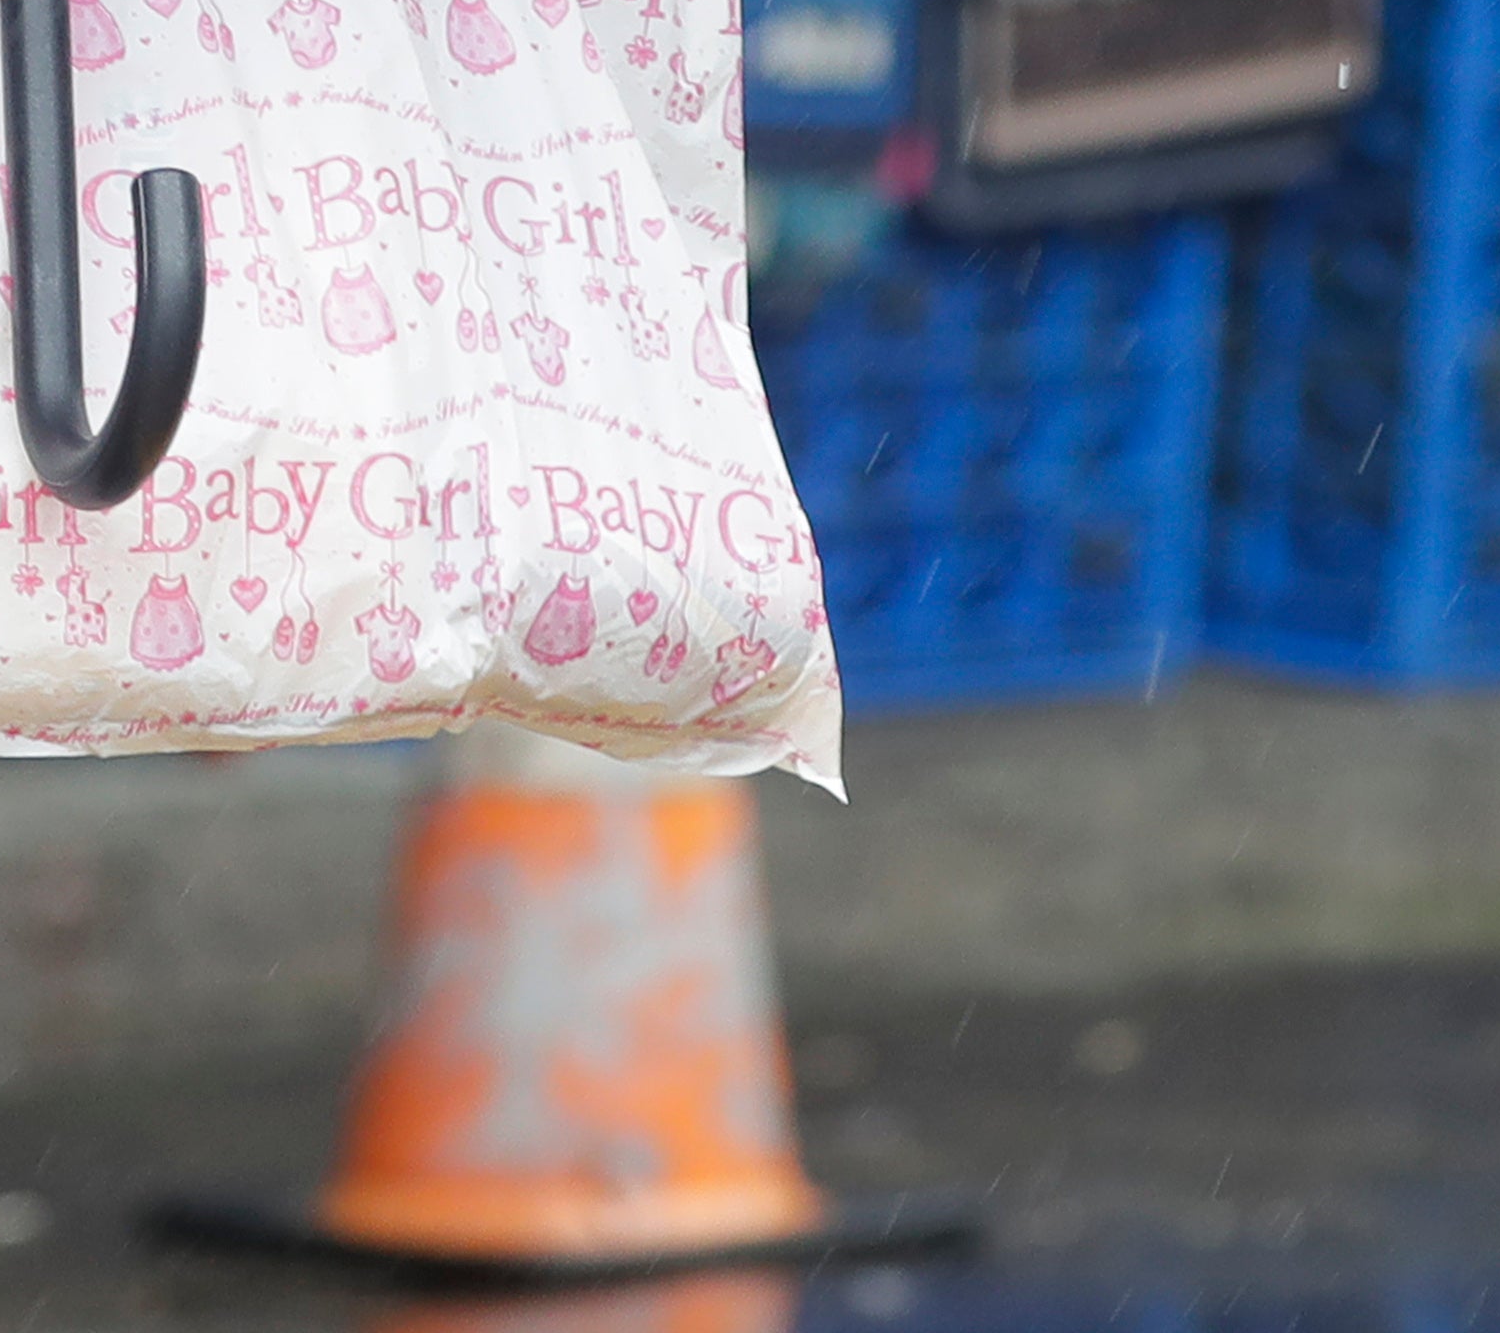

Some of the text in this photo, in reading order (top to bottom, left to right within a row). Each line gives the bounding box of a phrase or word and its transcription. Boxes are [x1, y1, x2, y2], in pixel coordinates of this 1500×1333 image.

[144, 93, 223, 130] Fashion
[231, 87, 274, 117] Shop
[312, 84, 391, 114] Fashion
[483, 169, 640, 268] Girl
[198, 402, 281, 430] Fashion
[288, 417, 340, 447] Shop
[434, 393, 485, 424] Shop
[573, 402, 622, 434] Shop
[128, 455, 337, 554] Baby
[349, 442, 501, 542] Girl
[531, 464, 706, 570] Baby
[203, 704, 279, 728] Fashion
[284, 692, 339, 719] Shop
